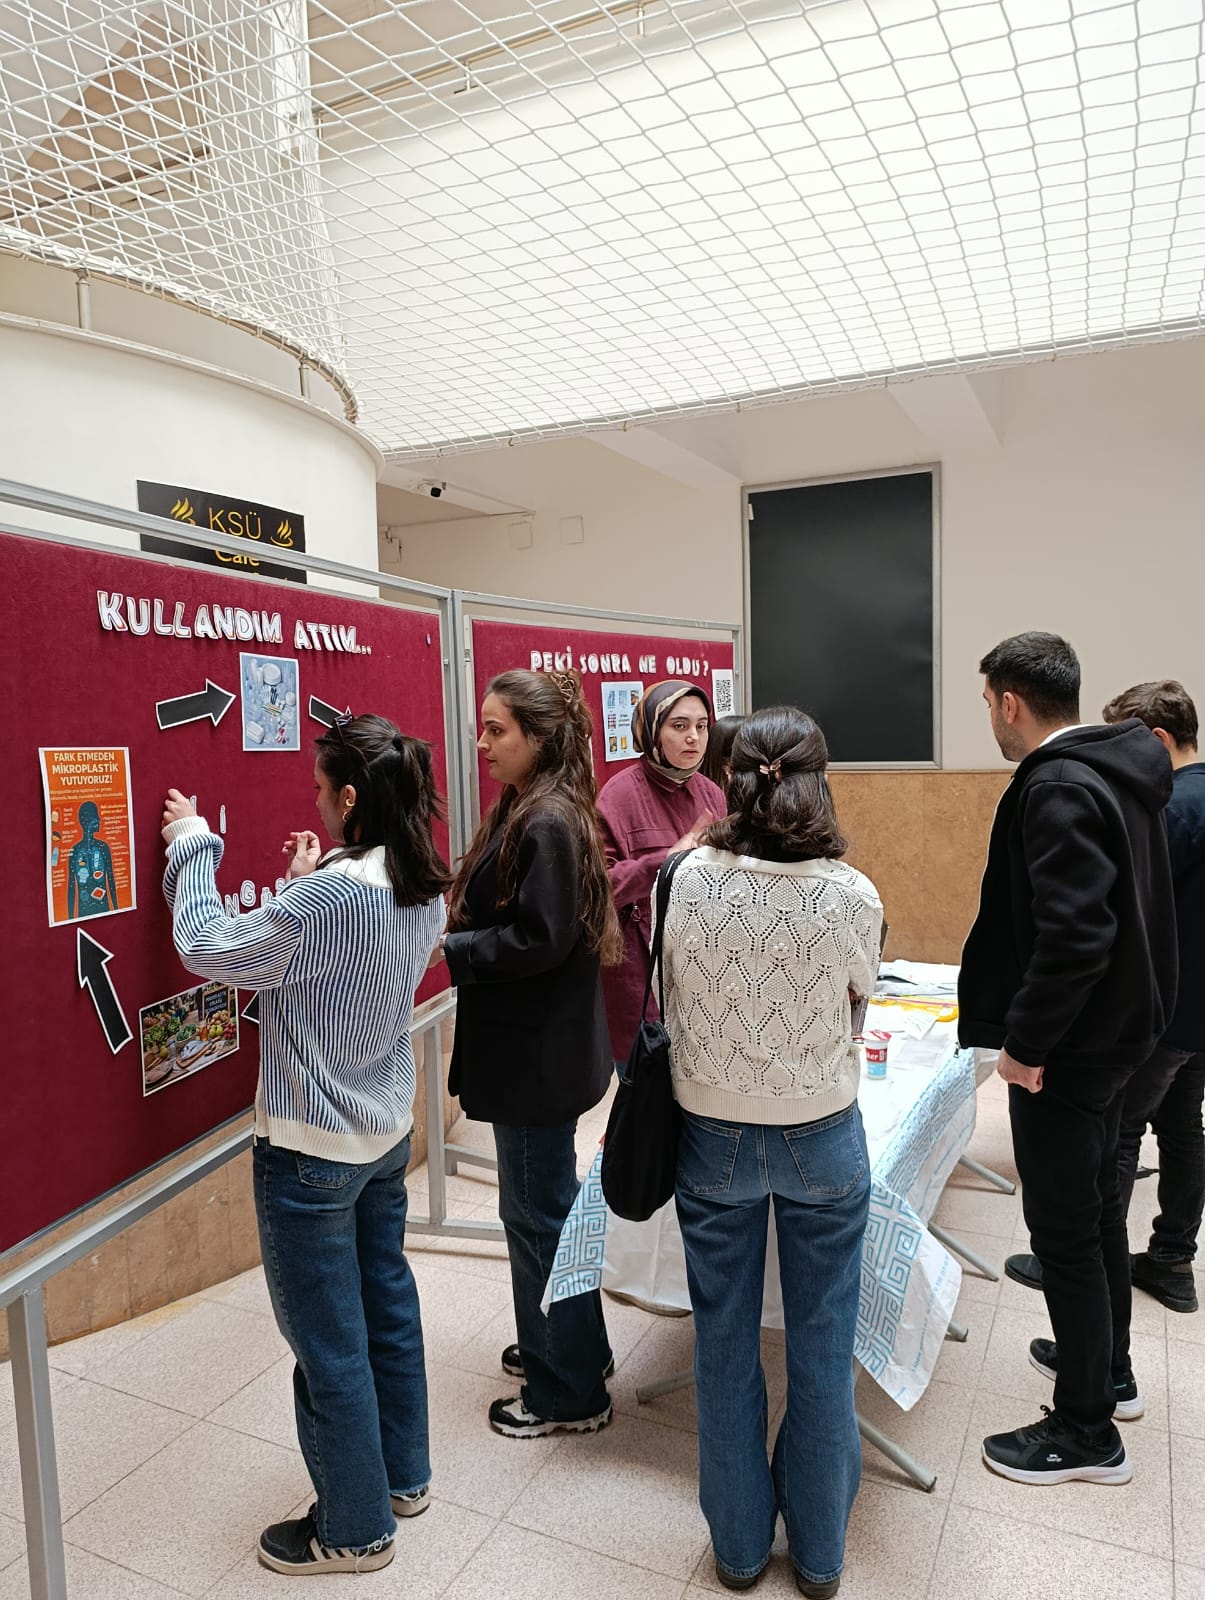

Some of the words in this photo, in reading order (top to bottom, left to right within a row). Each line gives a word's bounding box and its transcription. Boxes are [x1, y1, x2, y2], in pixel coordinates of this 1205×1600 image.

[208, 507, 262, 540] KSÜ
[97, 590, 283, 643] KULLANDIM
[530, 646, 573, 672] PEKİ
[580, 653, 632, 674] SONRA
[638, 654, 657, 674] NE
[54, 752, 76, 762] FARK
[77, 751, 115, 761] ETMEDEN
[52, 761, 119, 775] MİKROPLASTİK
[60, 774, 113, 786] YUTUYORUZ!
